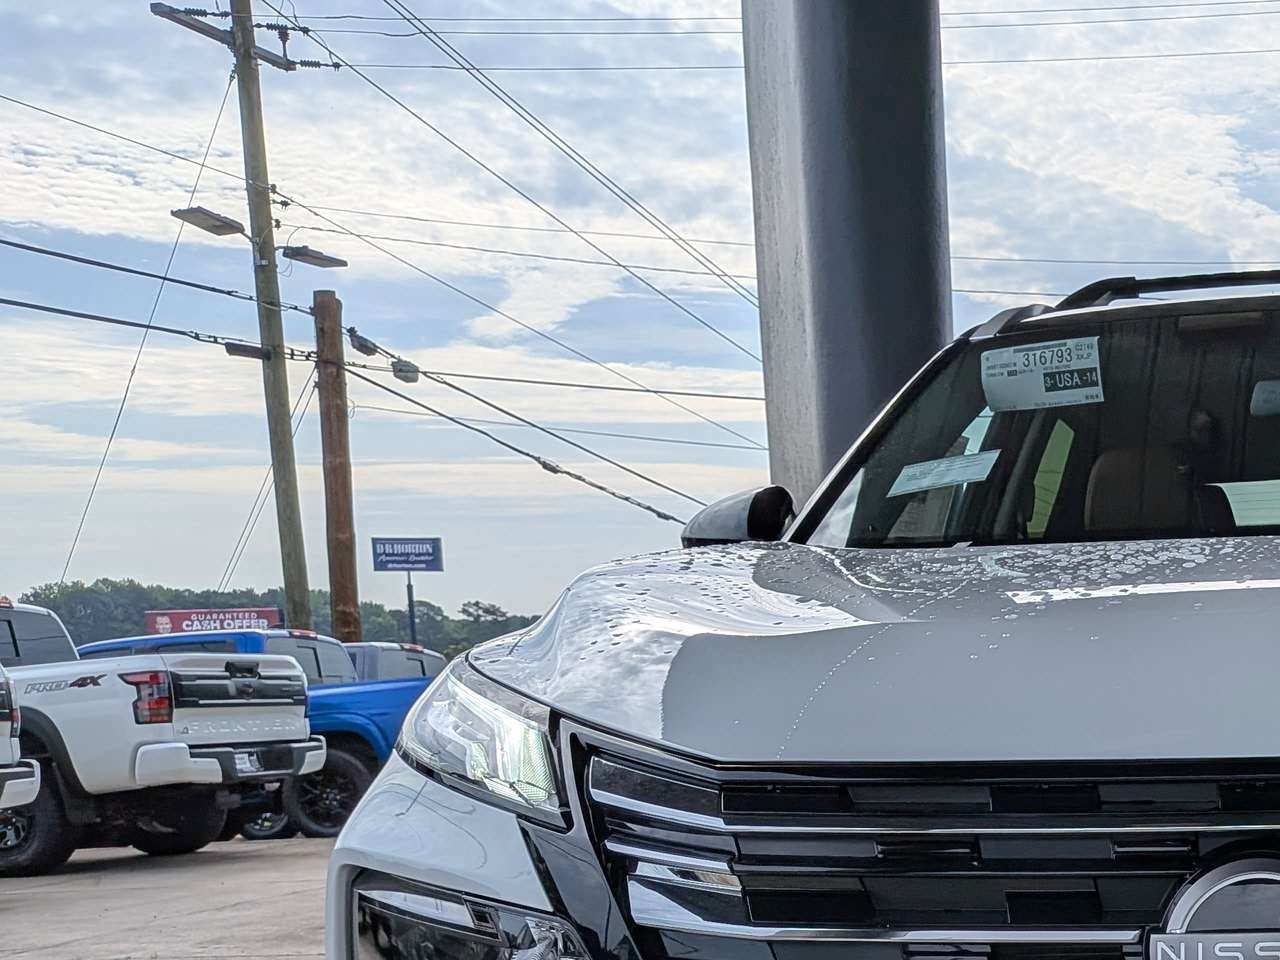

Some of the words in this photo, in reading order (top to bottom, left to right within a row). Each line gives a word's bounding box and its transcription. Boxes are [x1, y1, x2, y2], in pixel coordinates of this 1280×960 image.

[1022, 347, 1073, 367] 316793
[1055, 371, 1081, 388] USA
[190, 612, 258, 621] GUARANTEED
[182, 620, 221, 631] CASH
[223, 618, 269, 630] OFFER
